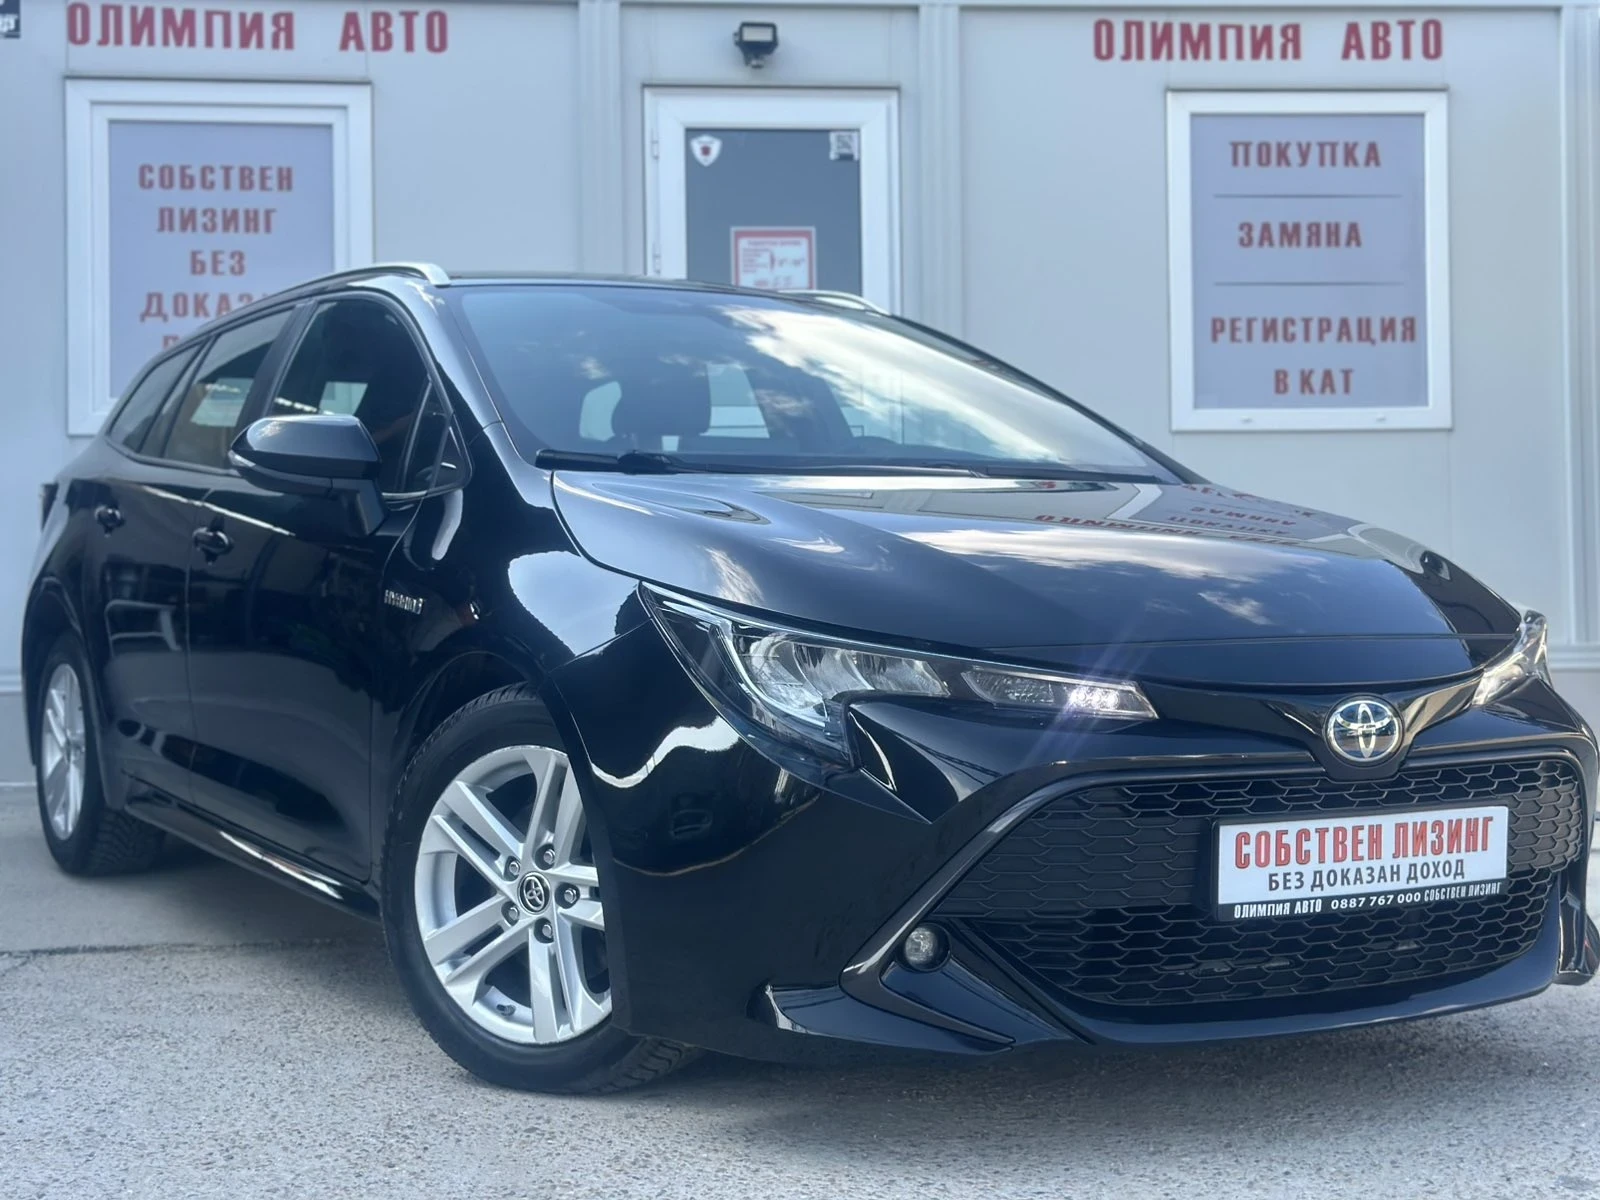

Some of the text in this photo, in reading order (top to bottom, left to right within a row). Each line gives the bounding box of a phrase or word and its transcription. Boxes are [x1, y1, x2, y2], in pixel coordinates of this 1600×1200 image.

[67, 2, 295, 50] ОЛИМПИЯ
[339, 10, 449, 53] АВТО
[1093, 19, 1443, 61] ОЛИМПИЯ АВТО
[1230, 141, 1382, 168] ПОКУПКА
[138, 163, 293, 192] СОБСТВЕН
[156, 207, 278, 234] ЛИЗИНГ
[1238, 222, 1363, 248] ЗАМЯНА
[190, 250, 246, 276] БЕЗ
[1211, 316, 1417, 346] РЕГИСТРАЦИЯ
[1274, 369, 1355, 395] В КАТ
[1234, 816, 1494, 870] СОБСТВЕН ЛИЗИНГ
[1268, 859, 1465, 892] БЕЗ ДОКАЗАН ДОХОД
[1233, 882, 1502, 919] ОЛИМПИЯ АВТО 0887 767 000 СОБСТВЕН ЛИЗИНГ
